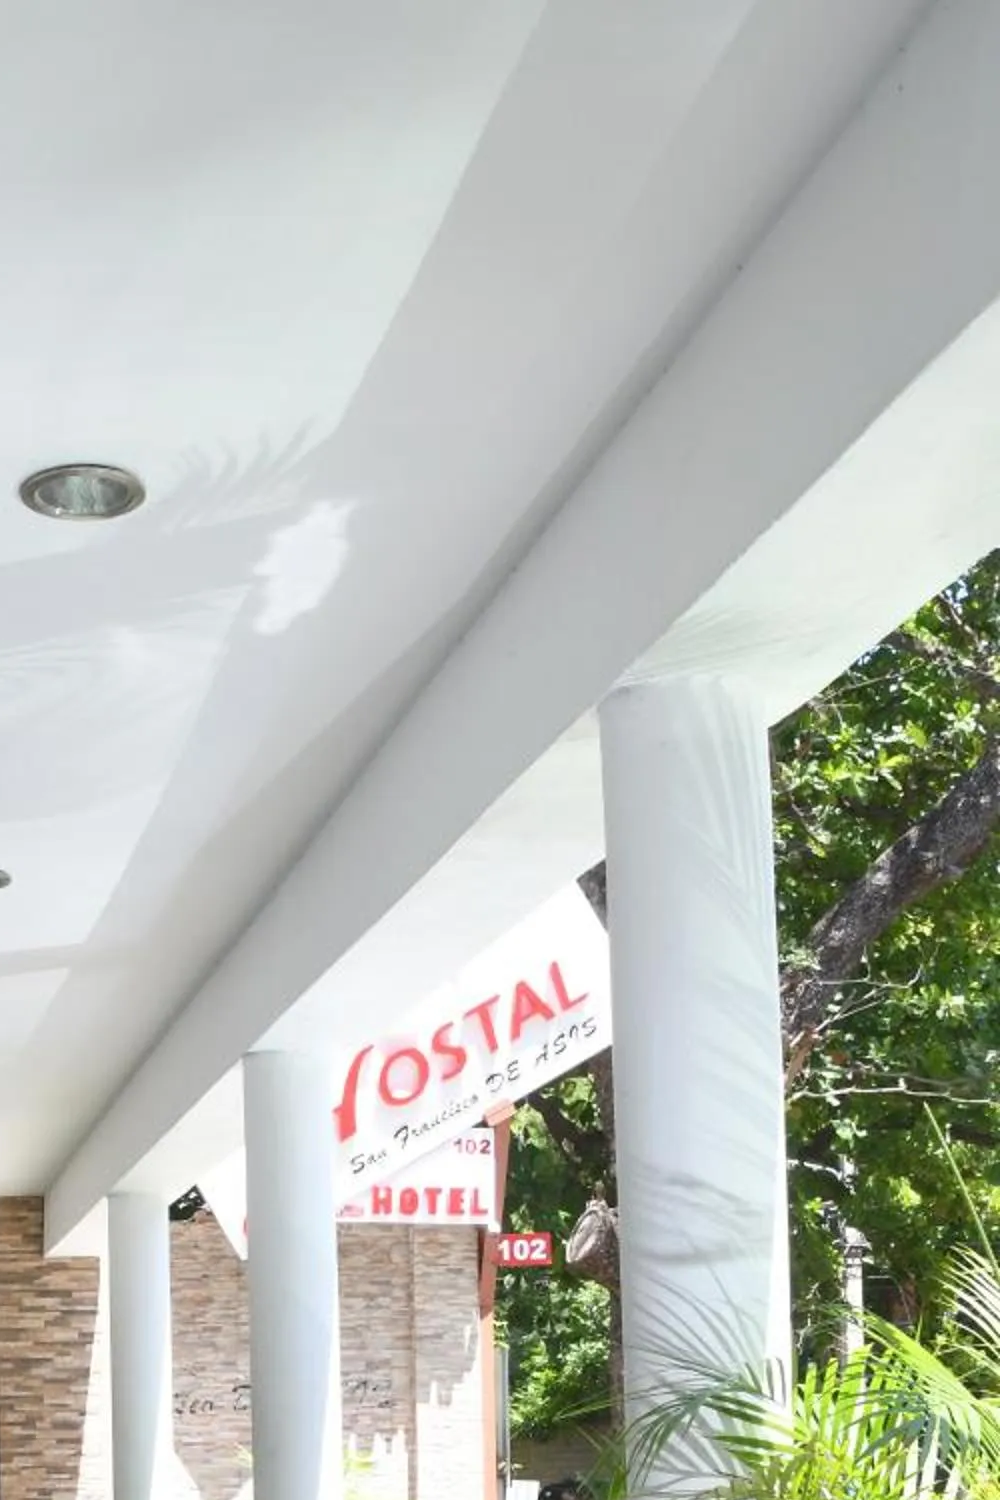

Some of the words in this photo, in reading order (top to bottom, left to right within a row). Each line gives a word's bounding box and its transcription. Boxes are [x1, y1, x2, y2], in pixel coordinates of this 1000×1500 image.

[350, 1150, 388, 1175] San
[485, 1059, 521, 1093] DE
[453, 1138, 491, 1155] 102
[370, 1185, 489, 1217] HOTEL
[498, 1238, 548, 1261] 102
